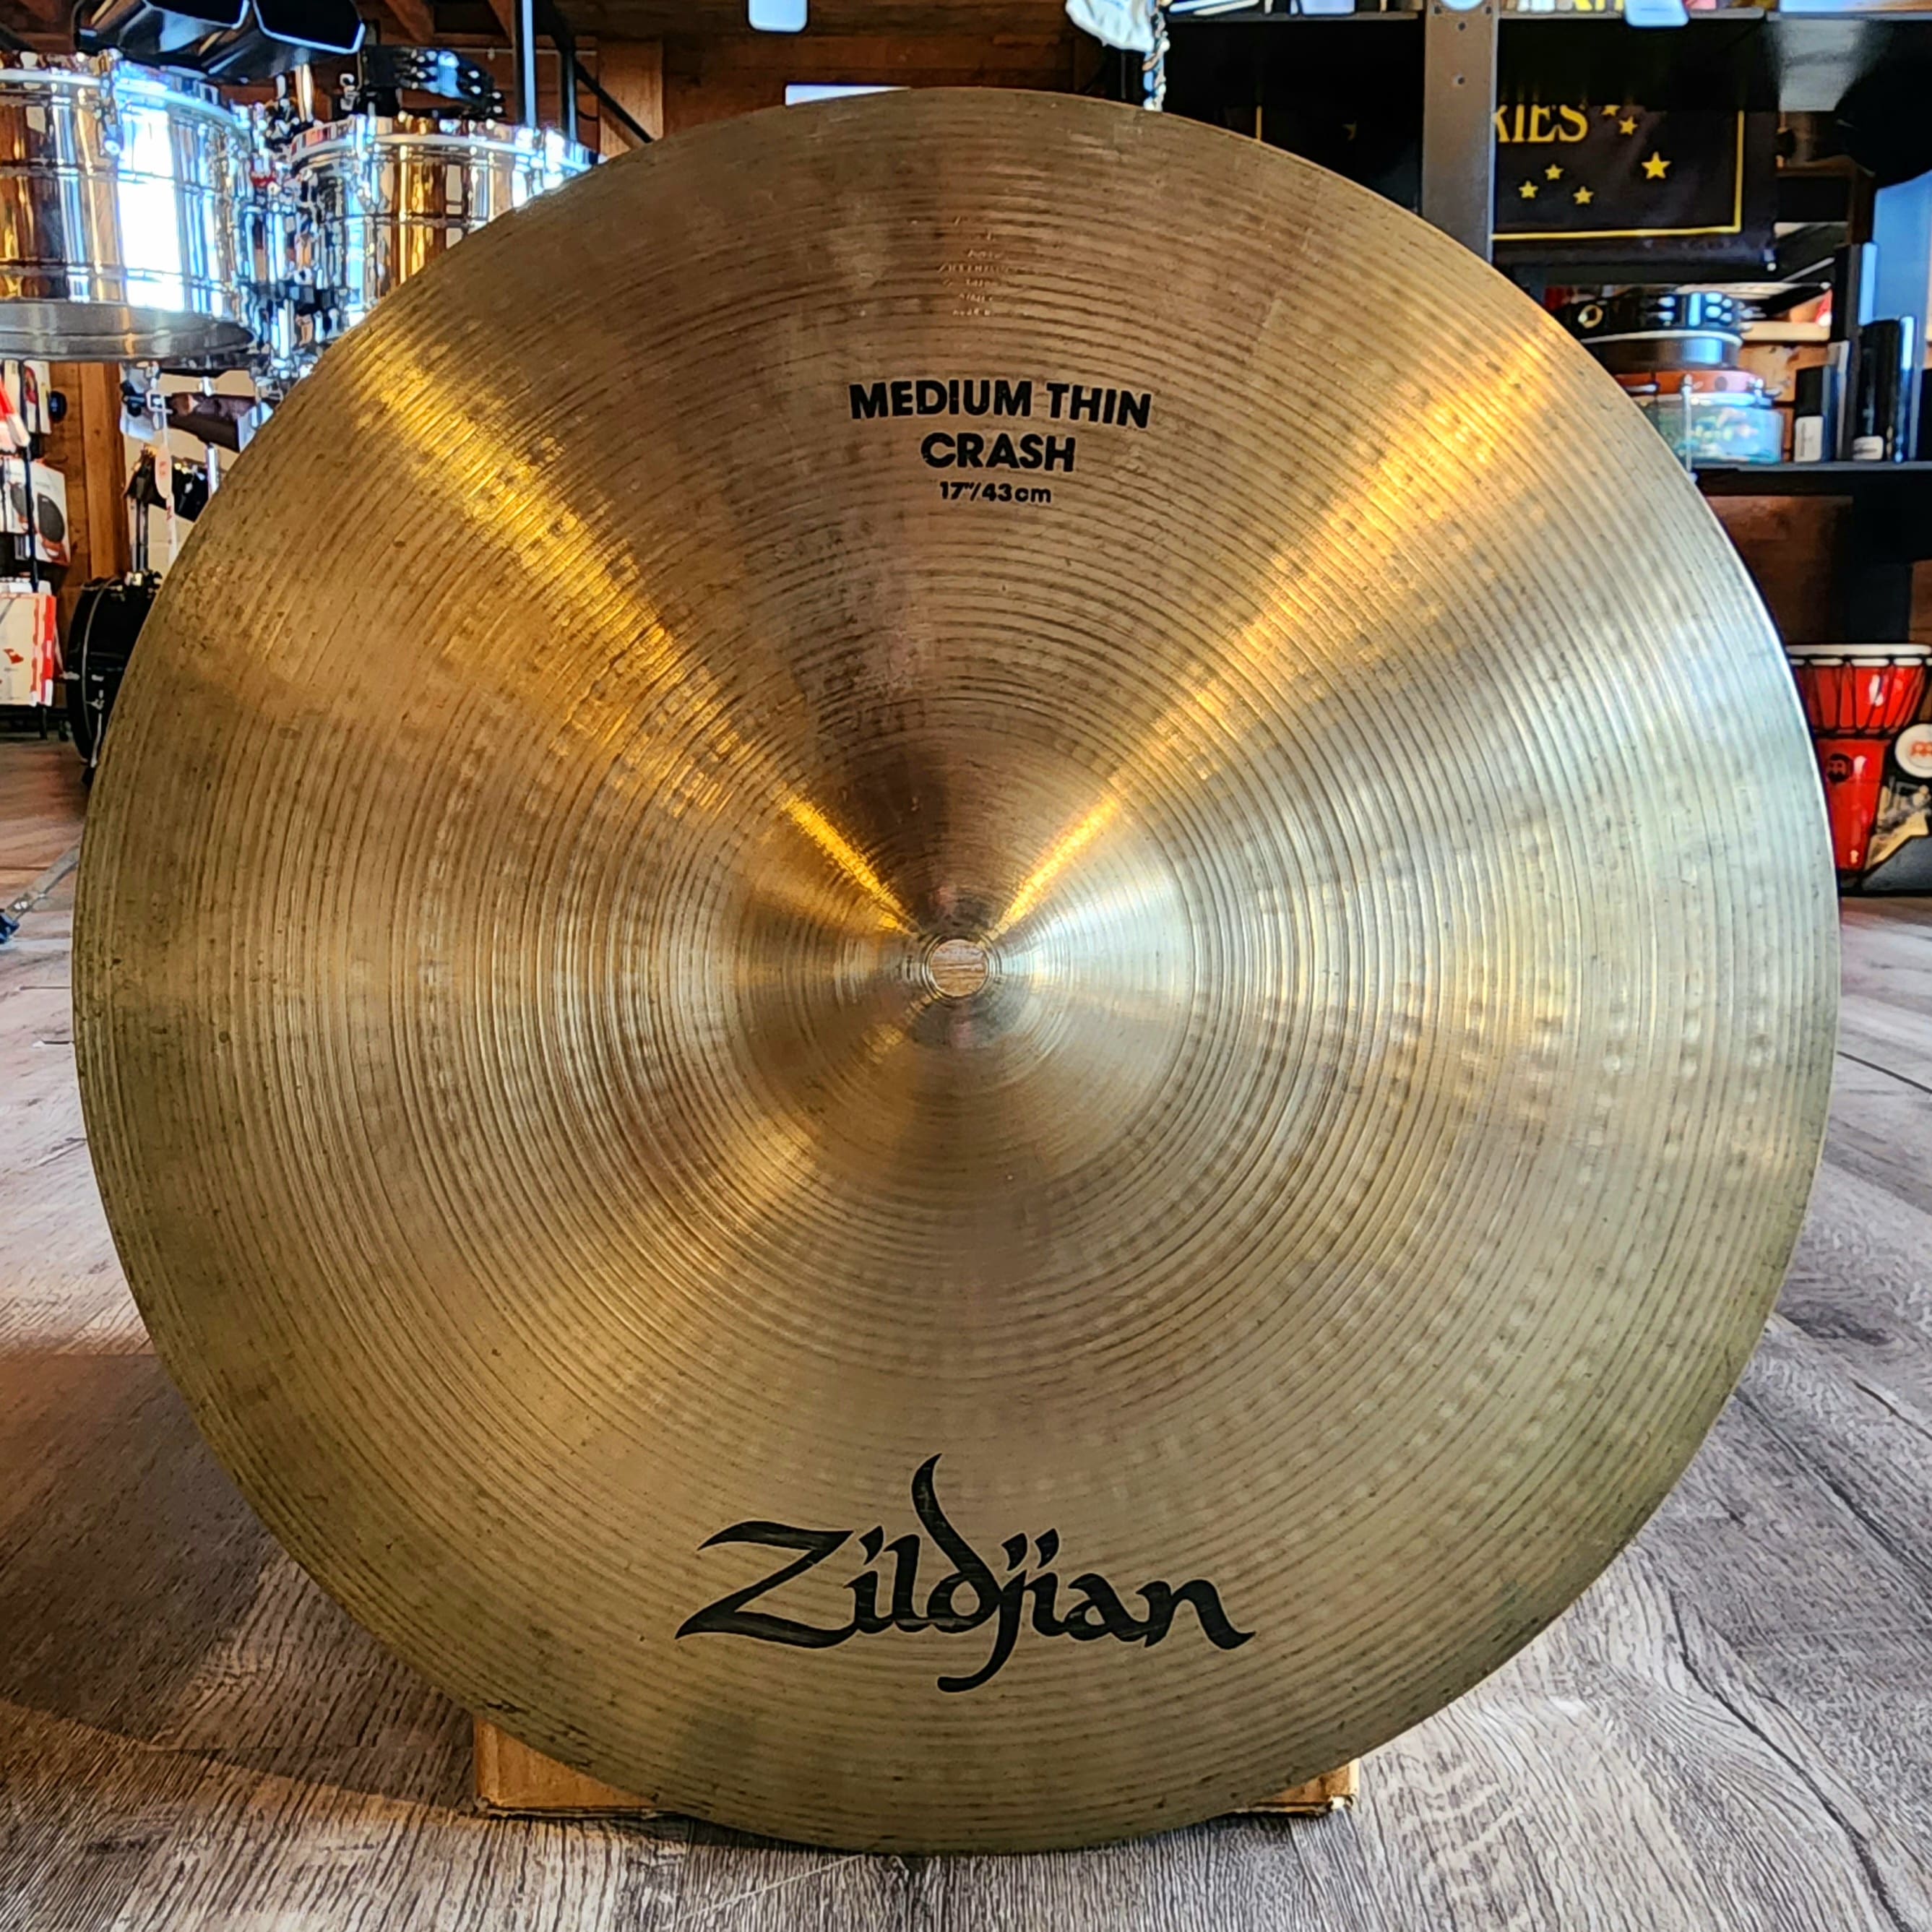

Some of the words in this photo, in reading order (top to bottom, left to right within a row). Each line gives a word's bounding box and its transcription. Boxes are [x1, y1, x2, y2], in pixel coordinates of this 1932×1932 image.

[849, 380, 1032, 420] MEDIUM
[1047, 383, 1152, 428] THIN
[920, 432, 1076, 472] CRASH
[675, 1454, 1256, 1692] Zildjian
